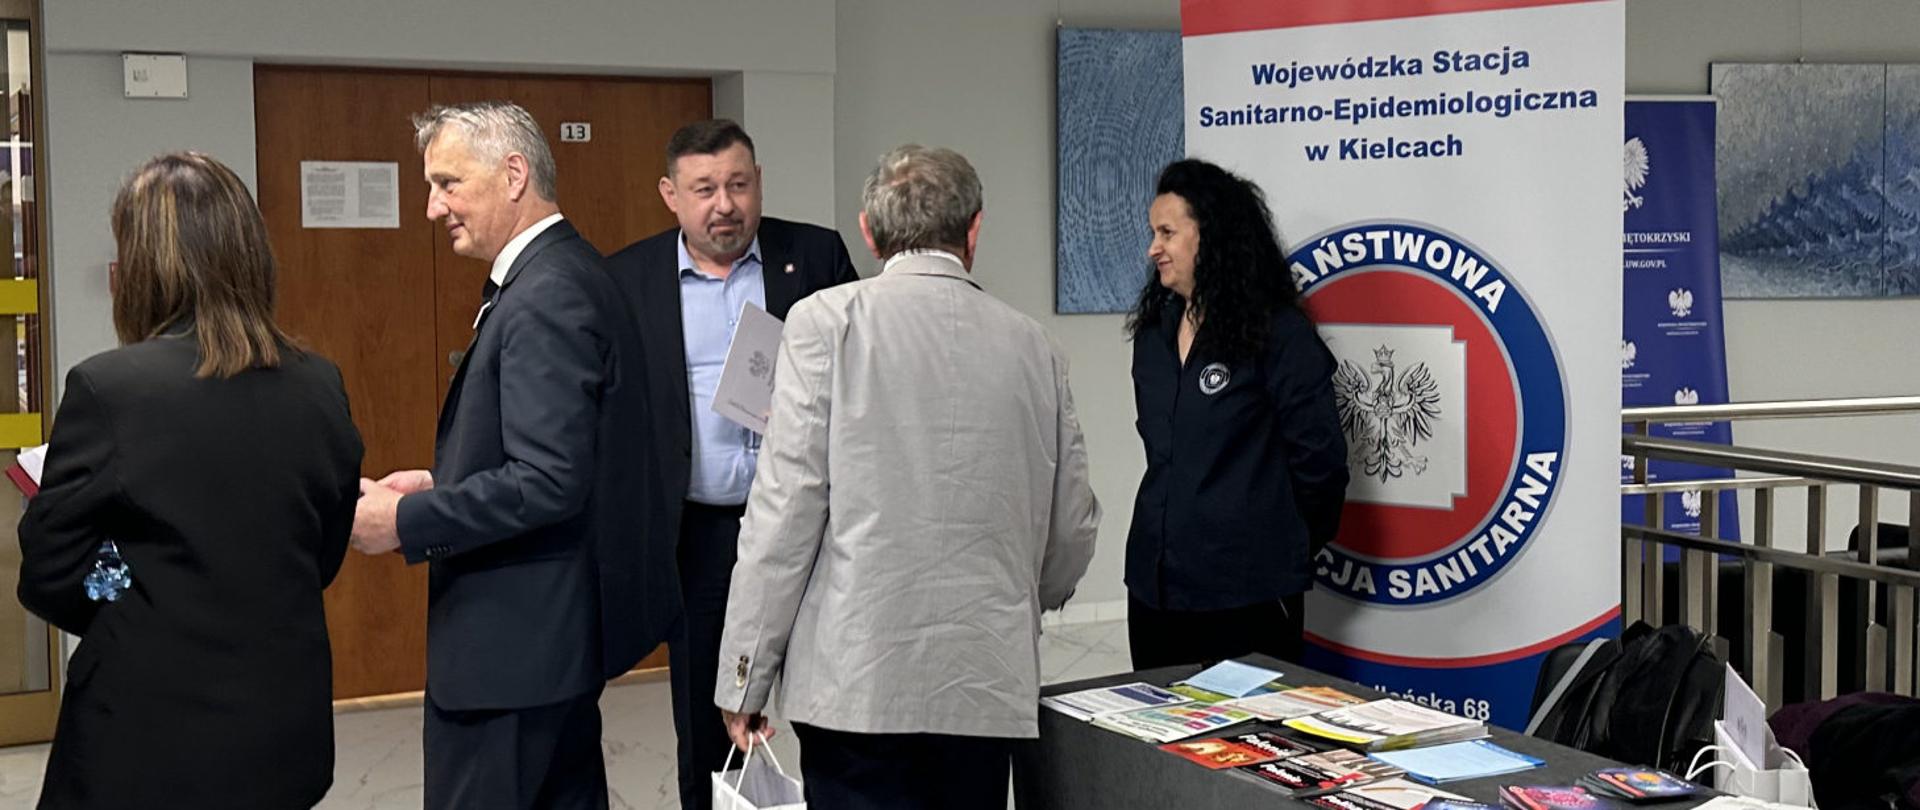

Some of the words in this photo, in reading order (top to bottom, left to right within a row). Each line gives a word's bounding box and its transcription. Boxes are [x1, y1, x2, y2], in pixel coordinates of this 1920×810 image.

[1251, 54, 1423, 88] Wojewódzka
[1432, 45, 1530, 76] Stacja
[1199, 86, 1598, 128] Sanitarno-Epidemiologiczna
[566, 124, 586, 140] 13
[1304, 144, 1330, 161] w
[1339, 133, 1463, 161] Kielcach
[1290, 230, 1507, 314] AŃSTWOWA
[1313, 548, 1377, 595] CJA
[1388, 451, 1558, 600] SANITARNA
[1463, 698, 1490, 720] 68
